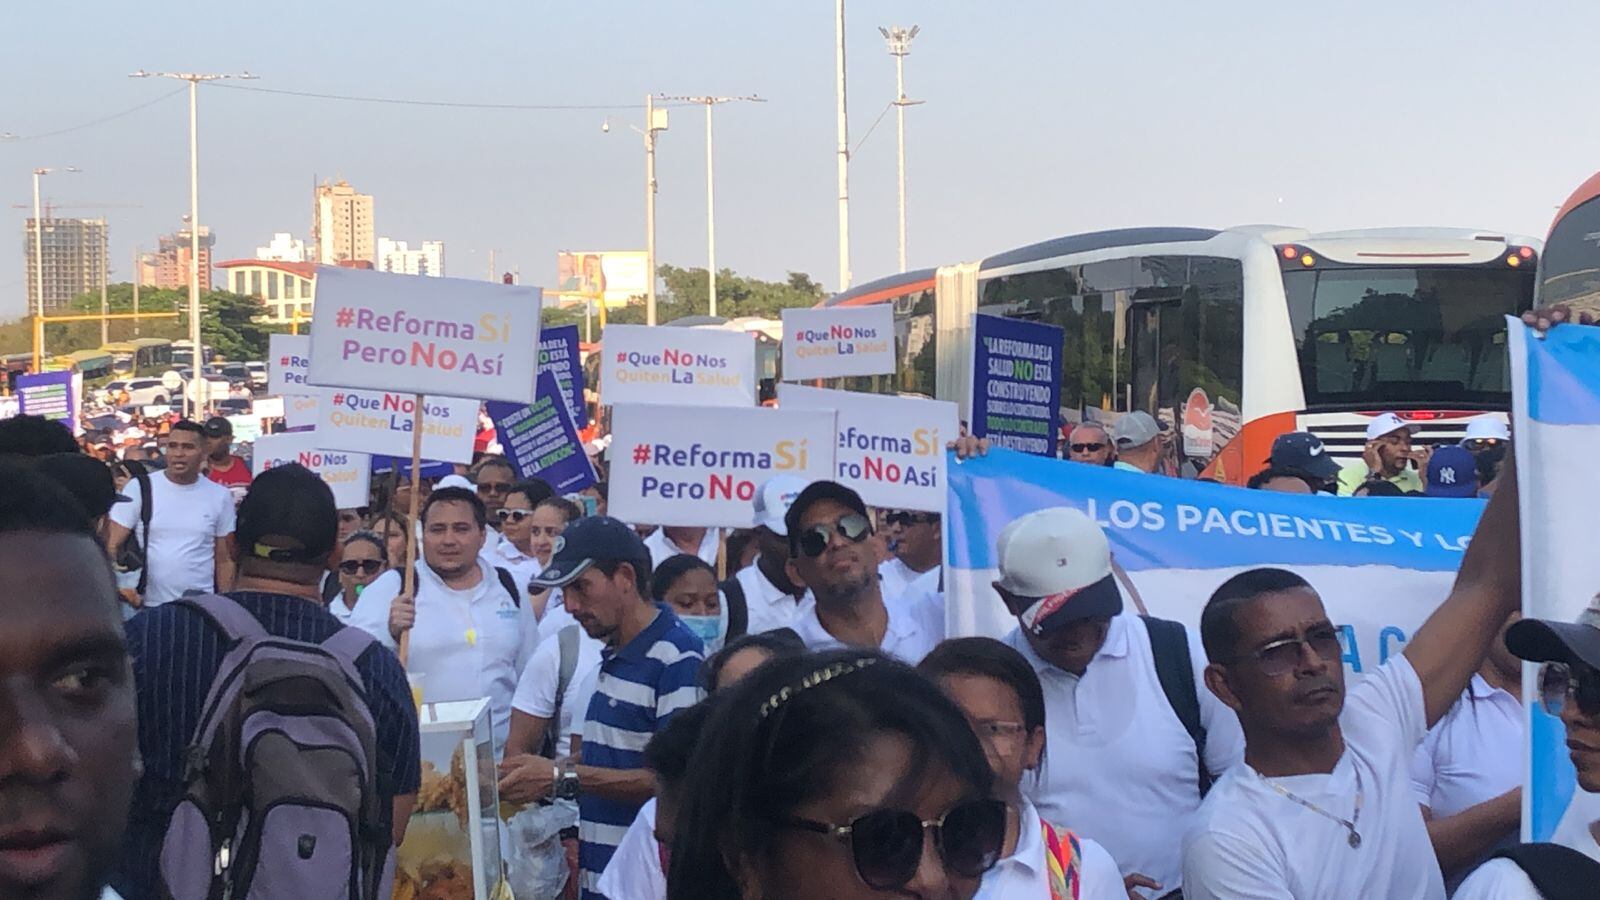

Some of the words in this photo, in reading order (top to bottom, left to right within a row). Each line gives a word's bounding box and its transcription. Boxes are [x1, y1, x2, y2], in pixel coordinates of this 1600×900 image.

[1014, 359, 1034, 381] NO
[1087, 498, 1165, 531] LOS
[1176, 504, 1395, 545] PACIENTES
[1399, 528, 1423, 548] Y
